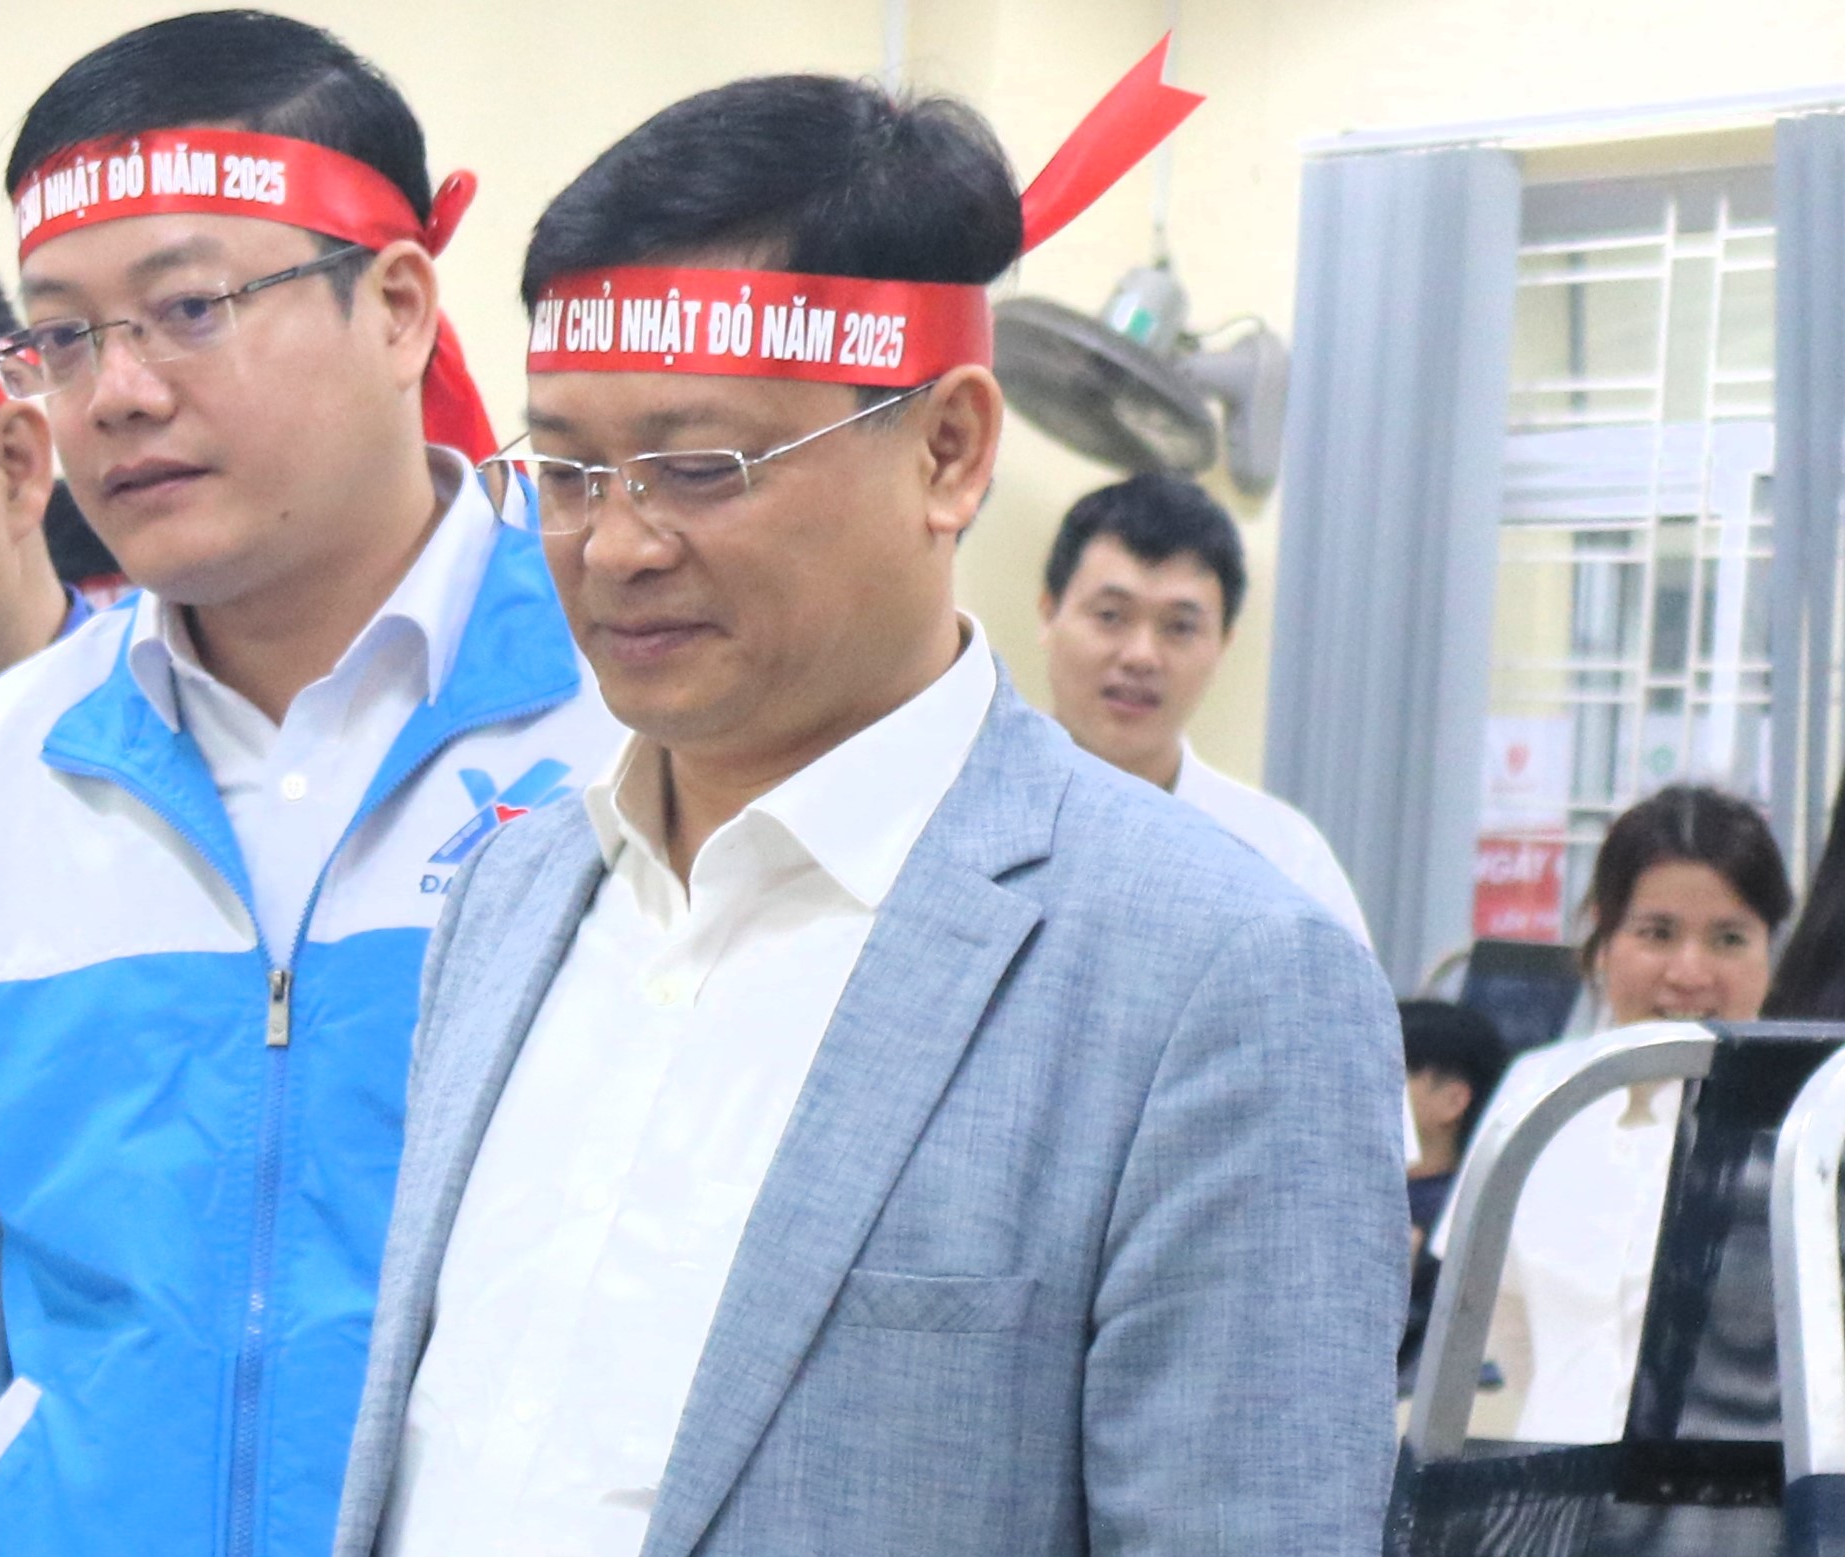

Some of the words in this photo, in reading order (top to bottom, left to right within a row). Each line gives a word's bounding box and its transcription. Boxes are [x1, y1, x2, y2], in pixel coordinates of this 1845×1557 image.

[44, 157, 101, 219] NHẬT
[107, 138, 145, 200] ĐỎ
[151, 143, 217, 196] NĂM
[223, 155, 286, 205] 2025
[565, 280, 614, 352] CHỦ
[620, 288, 702, 365] NHẬT
[707, 284, 753, 357] ĐỎ
[761, 295, 836, 363] NĂM
[839, 312, 906, 369] 2025
